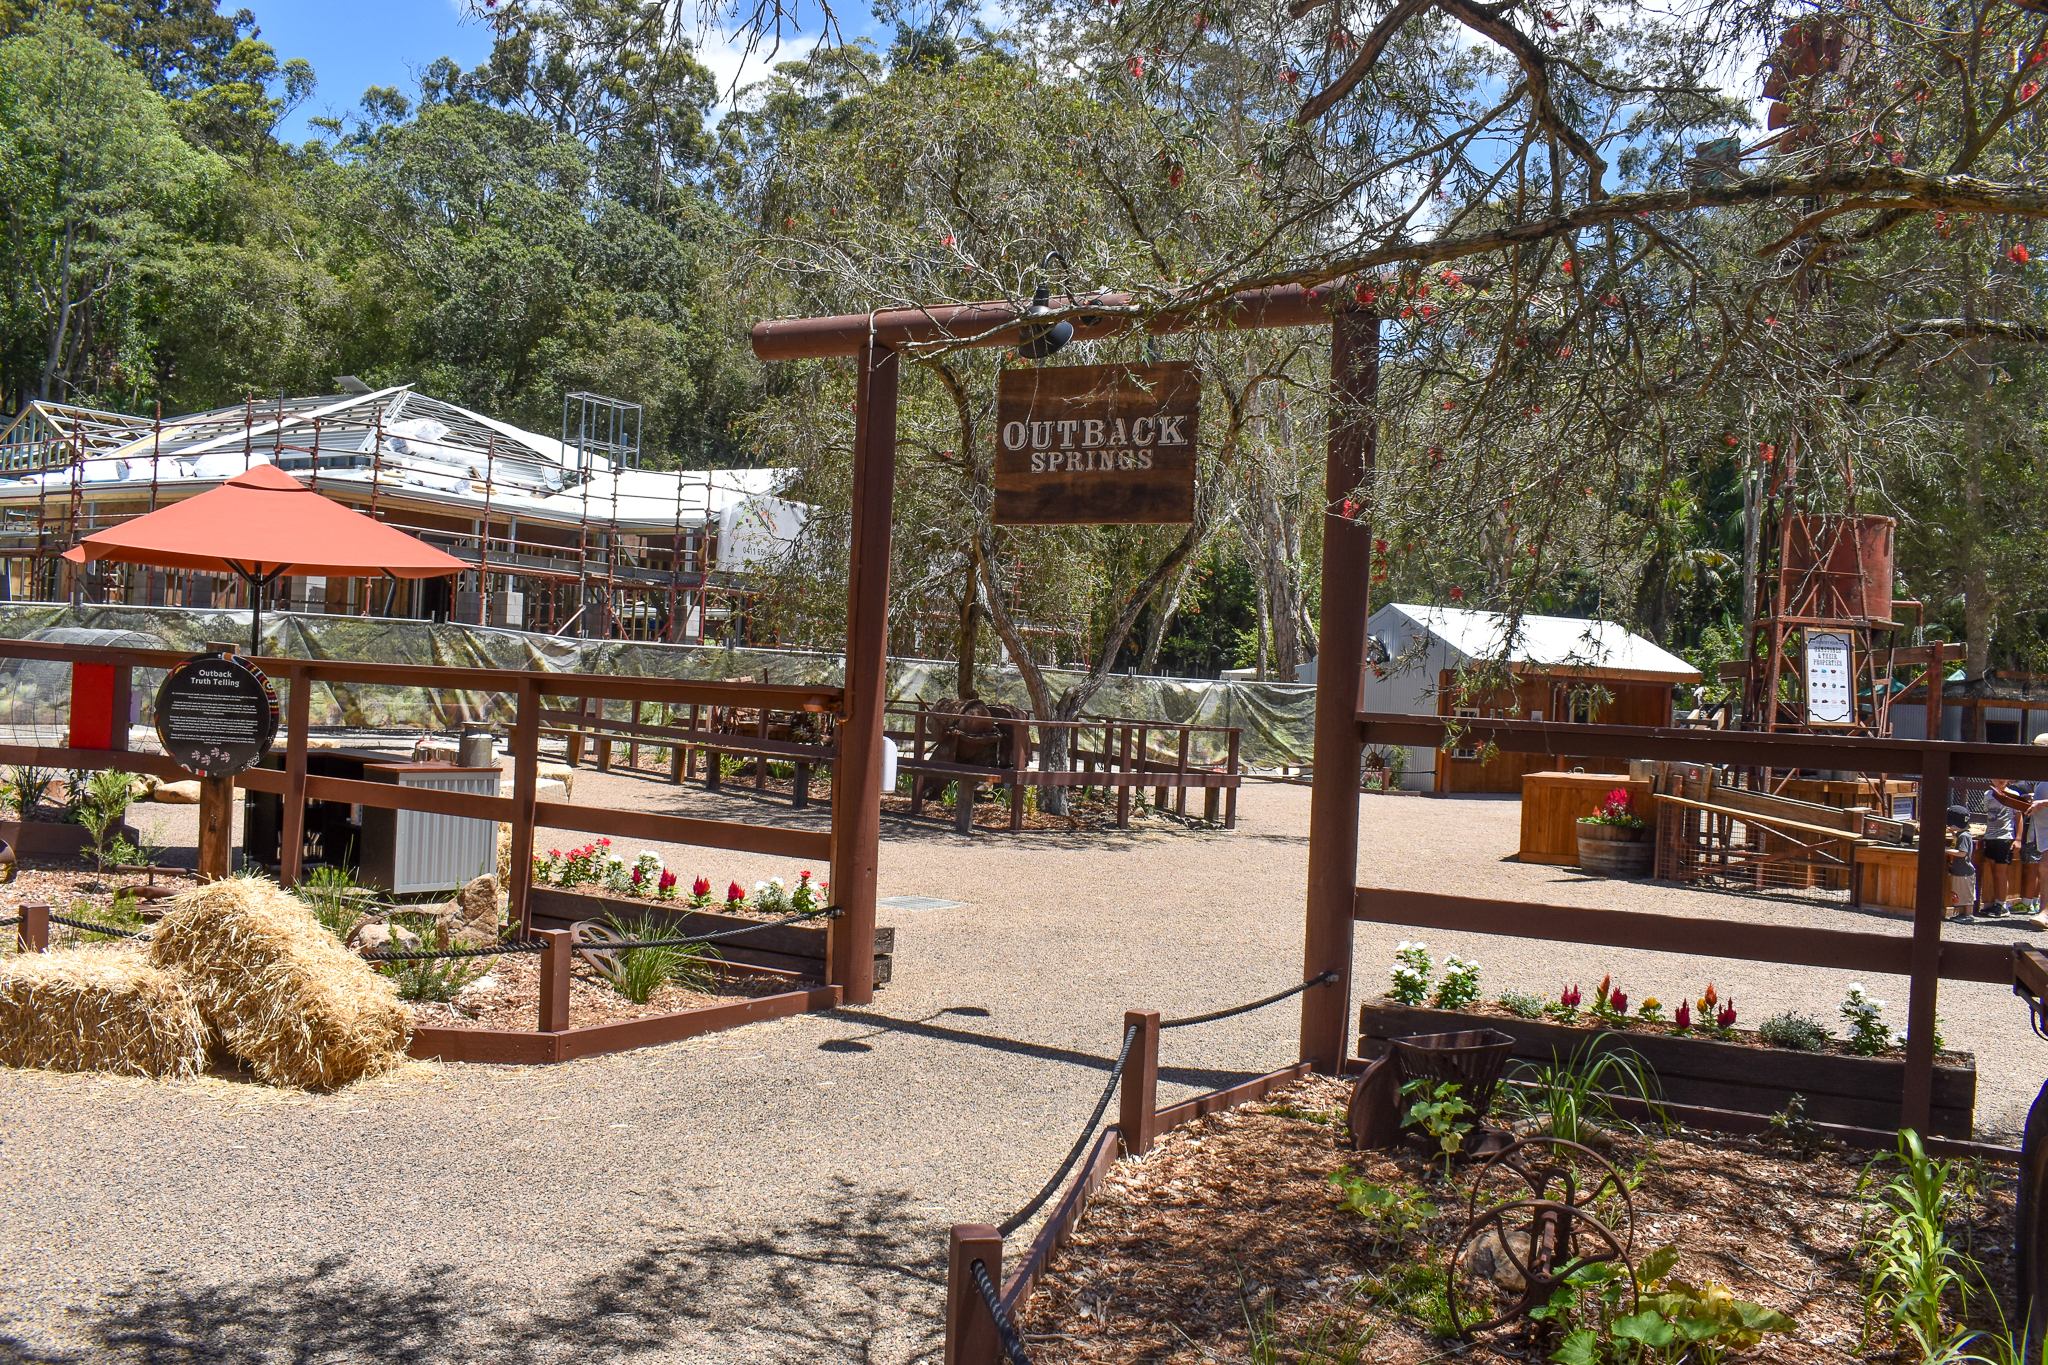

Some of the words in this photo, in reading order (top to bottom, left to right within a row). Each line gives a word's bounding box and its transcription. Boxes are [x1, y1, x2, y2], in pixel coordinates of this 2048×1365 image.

[1002, 415, 1188, 450] OUTBACK
[1031, 449, 1154, 474] SPRINGS
[743, 546, 756, 555] 0411
[199, 669, 232, 678] Outback
[190, 677, 211, 685] Truth
[213, 678, 240, 687] Telling
